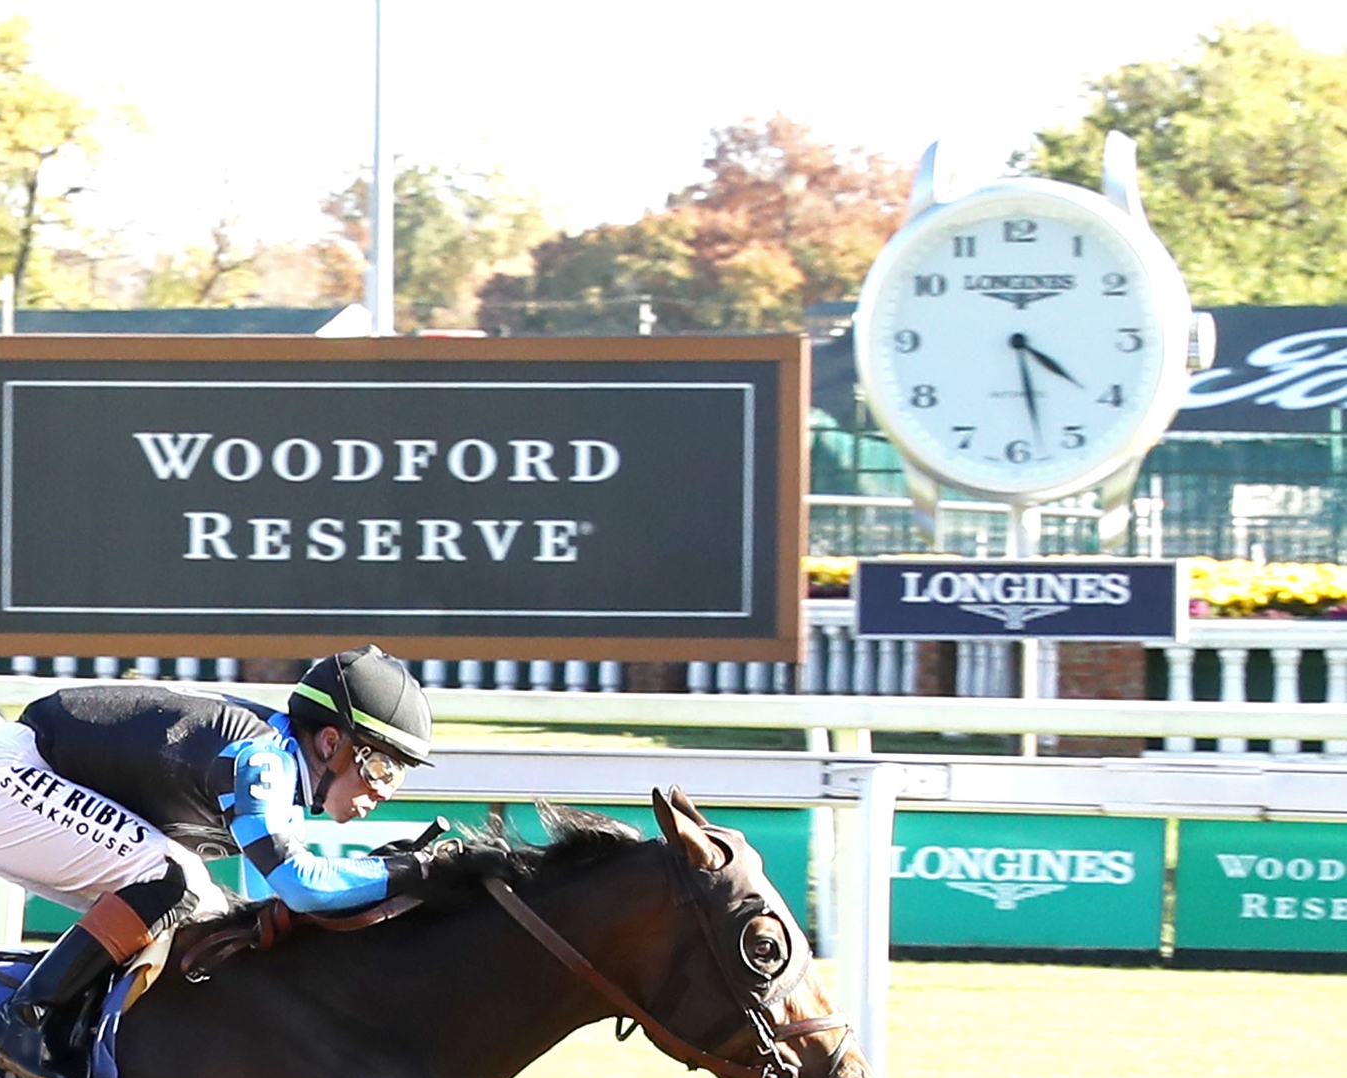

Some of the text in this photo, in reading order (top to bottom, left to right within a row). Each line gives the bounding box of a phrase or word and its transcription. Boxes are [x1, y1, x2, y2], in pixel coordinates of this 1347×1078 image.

[1002, 219, 1038, 243] 12
[952, 236, 976, 258] 11
[1071, 235, 1084, 257] 1
[913, 274, 948, 297] 10
[963, 274, 1077, 291] LONGINES
[1101, 272, 1128, 297] 2
[894, 329, 921, 354] 9
[1116, 327, 1145, 353] 3
[910, 384, 938, 409] 8
[1096, 384, 1124, 408] 4
[952, 425, 976, 449] 7
[1061, 425, 1087, 449] 5
[133, 432, 622, 484] WOODFORD
[1005, 440, 1031, 465] 6
[182, 511, 579, 564] RESERVE
[900, 571, 1132, 605] LONGINES
[248, 752, 284, 801] 3
[0, 776, 132, 857] STEAKHOUSE
[64, 788, 151, 845] RUBY'S
[890, 845, 1135, 884] LONGINES
